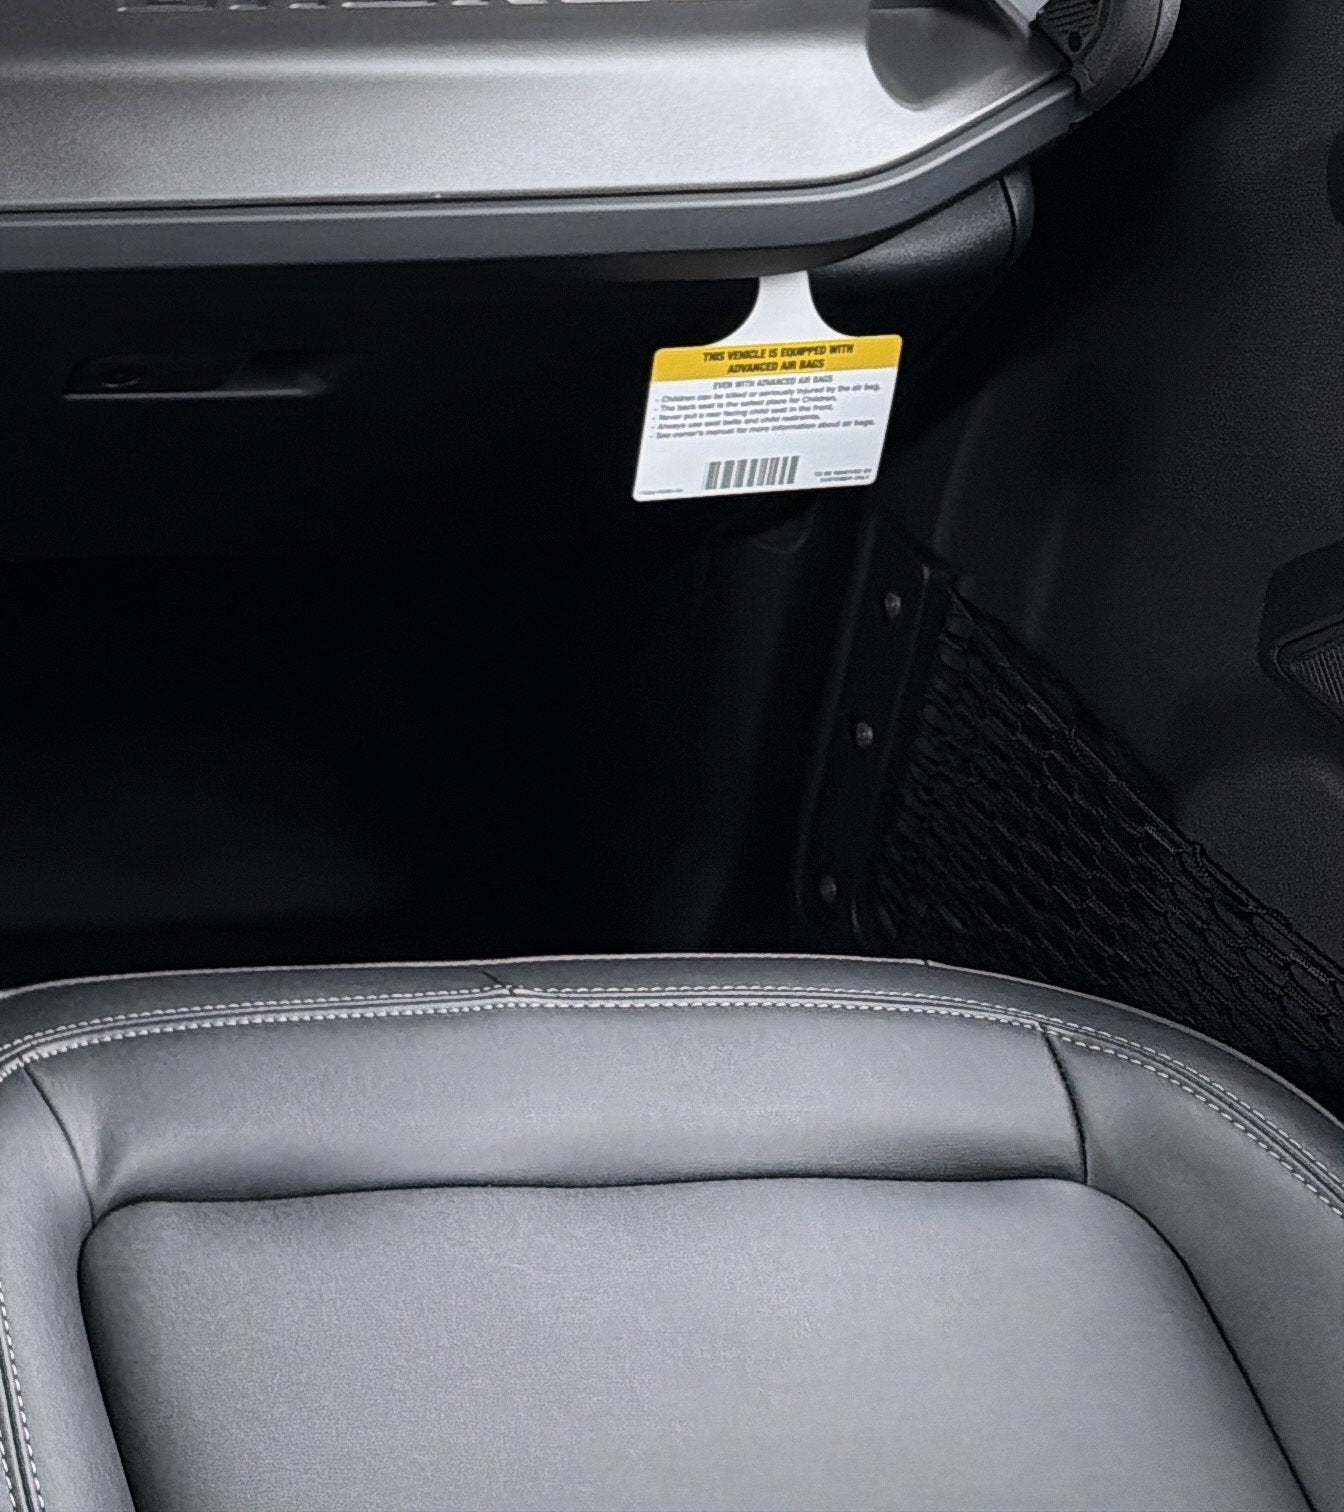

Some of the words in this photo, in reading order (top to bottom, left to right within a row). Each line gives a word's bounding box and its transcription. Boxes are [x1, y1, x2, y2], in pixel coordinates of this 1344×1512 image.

[703, 350, 725, 363] THIS
[728, 348, 766, 361] VEHICLE
[768, 347, 778, 359] IS
[780, 345, 827, 358] EQUIPPED
[829, 343, 854, 355] WITH
[727, 361, 778, 374] ADVANCED
[779, 360, 798, 372] AIR
[799, 358, 825, 370] BAGS
